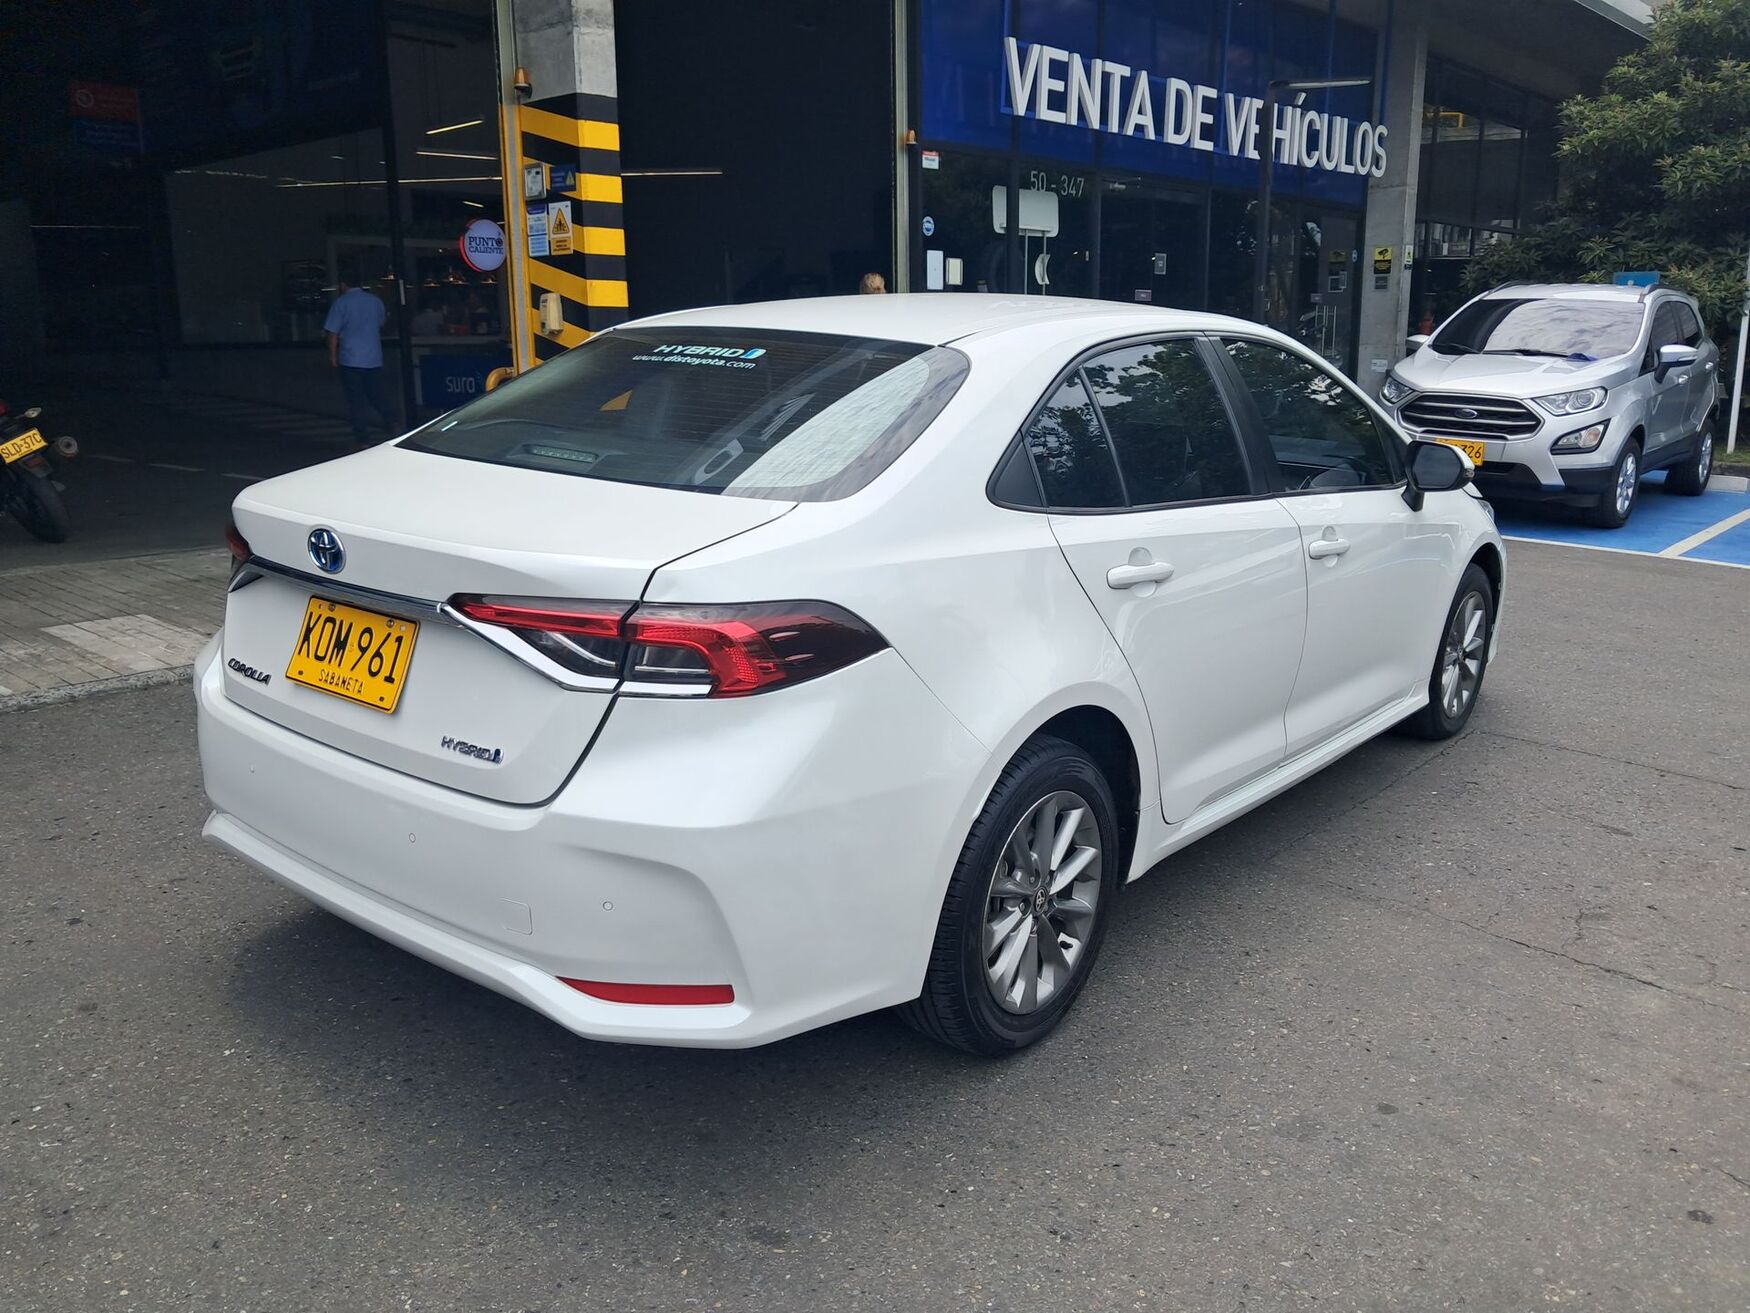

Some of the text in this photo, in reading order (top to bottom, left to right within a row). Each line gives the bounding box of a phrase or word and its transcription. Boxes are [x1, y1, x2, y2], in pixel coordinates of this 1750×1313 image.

[1004, 36, 1388, 178] VENTA DE VEHÍCULOS
[1030, 170, 1047, 192] 50
[1060, 174, 1085, 198] 347
[468, 236, 503, 247] PUNTO
[468, 246, 504, 255] CALIENTE
[632, 353, 757, 370] www.distoyota.com
[653, 344, 746, 358] HYBRID
[446, 376, 476, 393] sura
[298, 611, 404, 684] KOM 961
[227, 657, 272, 686] COROLLA
[318, 668, 365, 695] SABANETA
[441, 736, 493, 762] HYBRID
